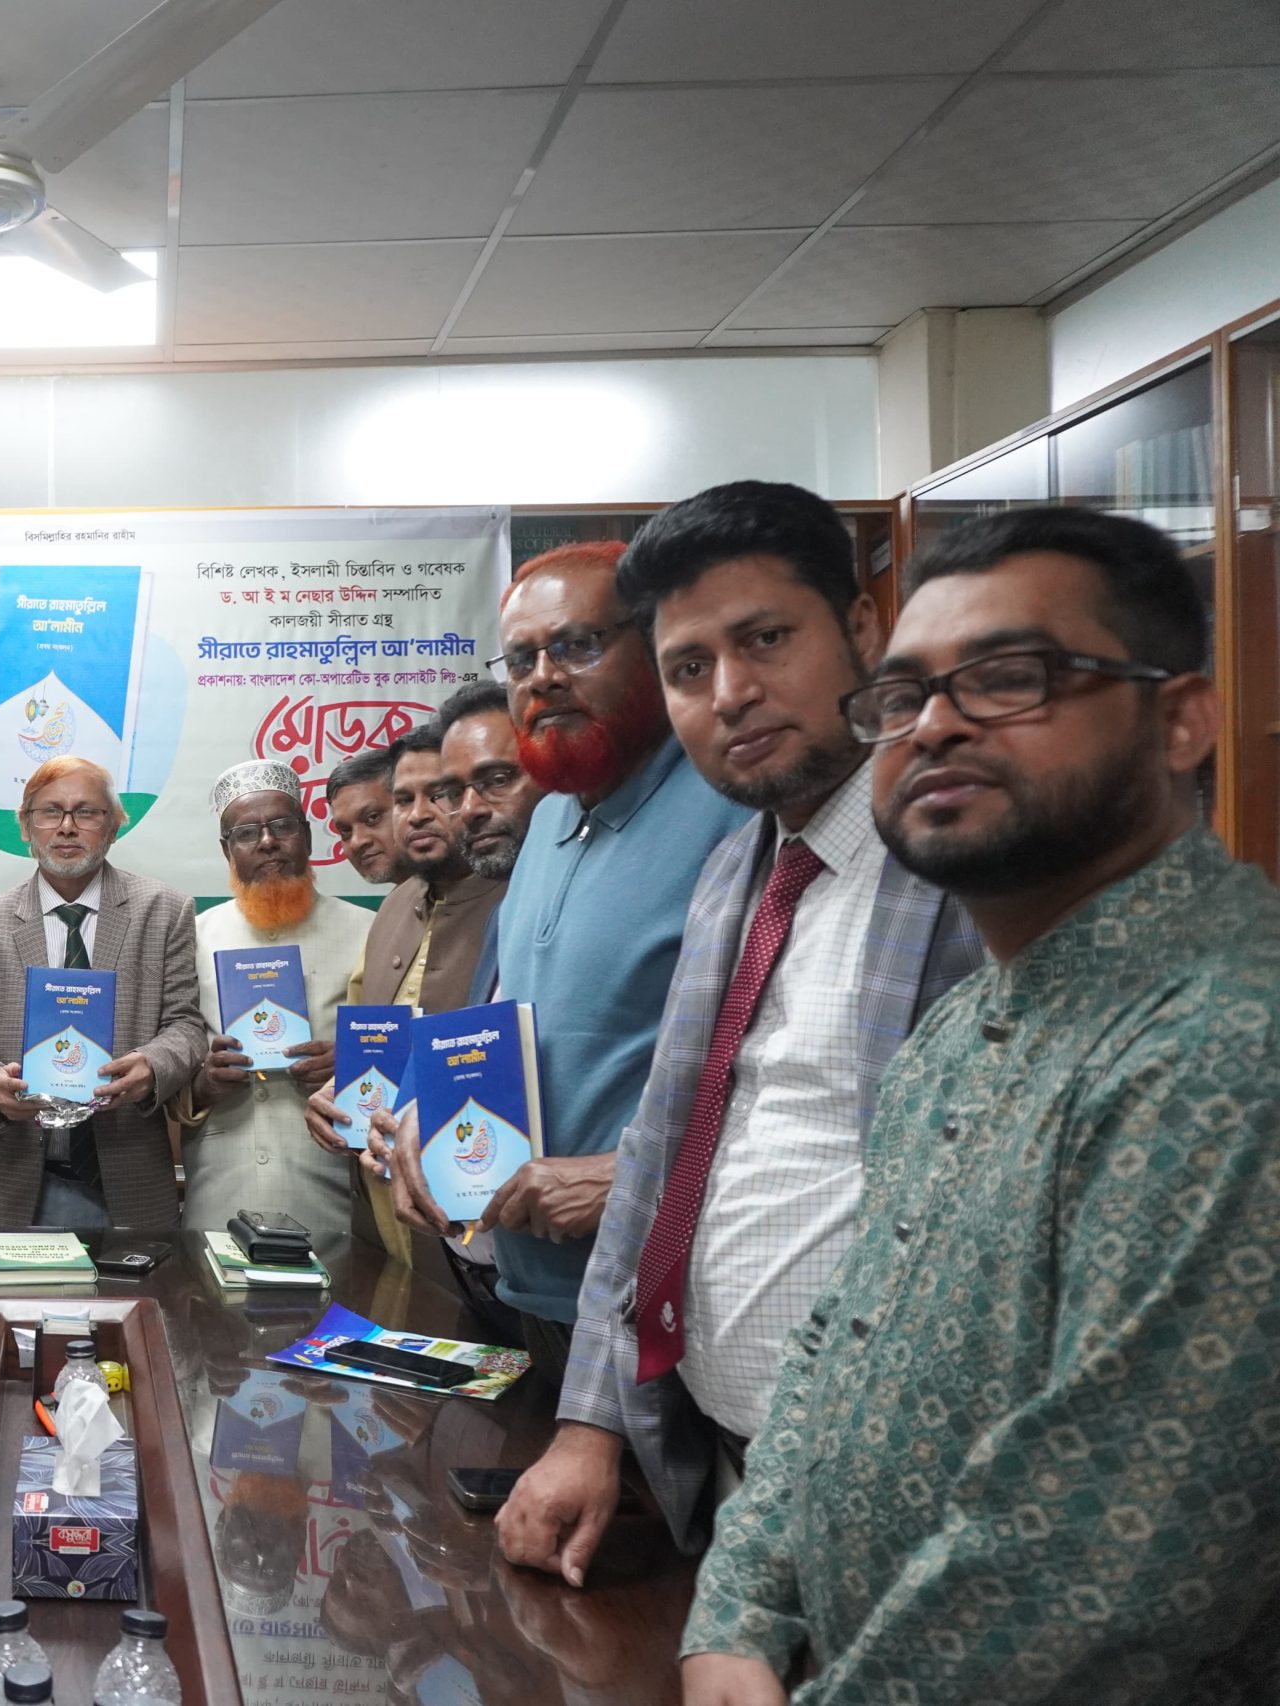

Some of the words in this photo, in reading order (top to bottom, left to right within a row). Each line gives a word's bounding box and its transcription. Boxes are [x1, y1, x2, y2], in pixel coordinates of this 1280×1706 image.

[25, 530, 71, 542] বিসমিল্লাহির
[75, 529, 109, 541] রহমানির
[113, 529, 136, 541] রাহীম
[197, 562, 235, 579] বিশিষ্ট
[240, 566, 285, 581] লেখক,
[291, 560, 340, 577] ইসলামী
[345, 560, 395, 577] চিন্তাবিদ
[402, 564, 412, 575] ও
[418, 562, 466, 576] গবেষক
[17, 594, 48, 610] সীরাতে
[220, 591, 236, 604] ড.
[242, 591, 260, 604] আ
[264, 587, 275, 604] ই
[280, 590, 291, 603] ম
[296, 590, 334, 603] নেছার
[339, 585, 378, 602] উদ্দিন
[382, 584, 443, 601] সম্পাদিত
[269, 610, 323, 628] কালজয়ী
[327, 610, 369, 628] সীরাত
[372, 614, 395, 629] গ্রন্থ
[198, 636, 262, 661] সীরাতে
[265, 635, 377, 667] রাহমাতুল্লিল
[381, 633, 476, 657] আ'লামীন
[249, 673, 296, 687] বাংলাদেশ
[299, 669, 371, 687] কো-অপারেটিভ
[374, 671, 391, 688] বুক
[394, 668, 437, 685] সোসাইটি
